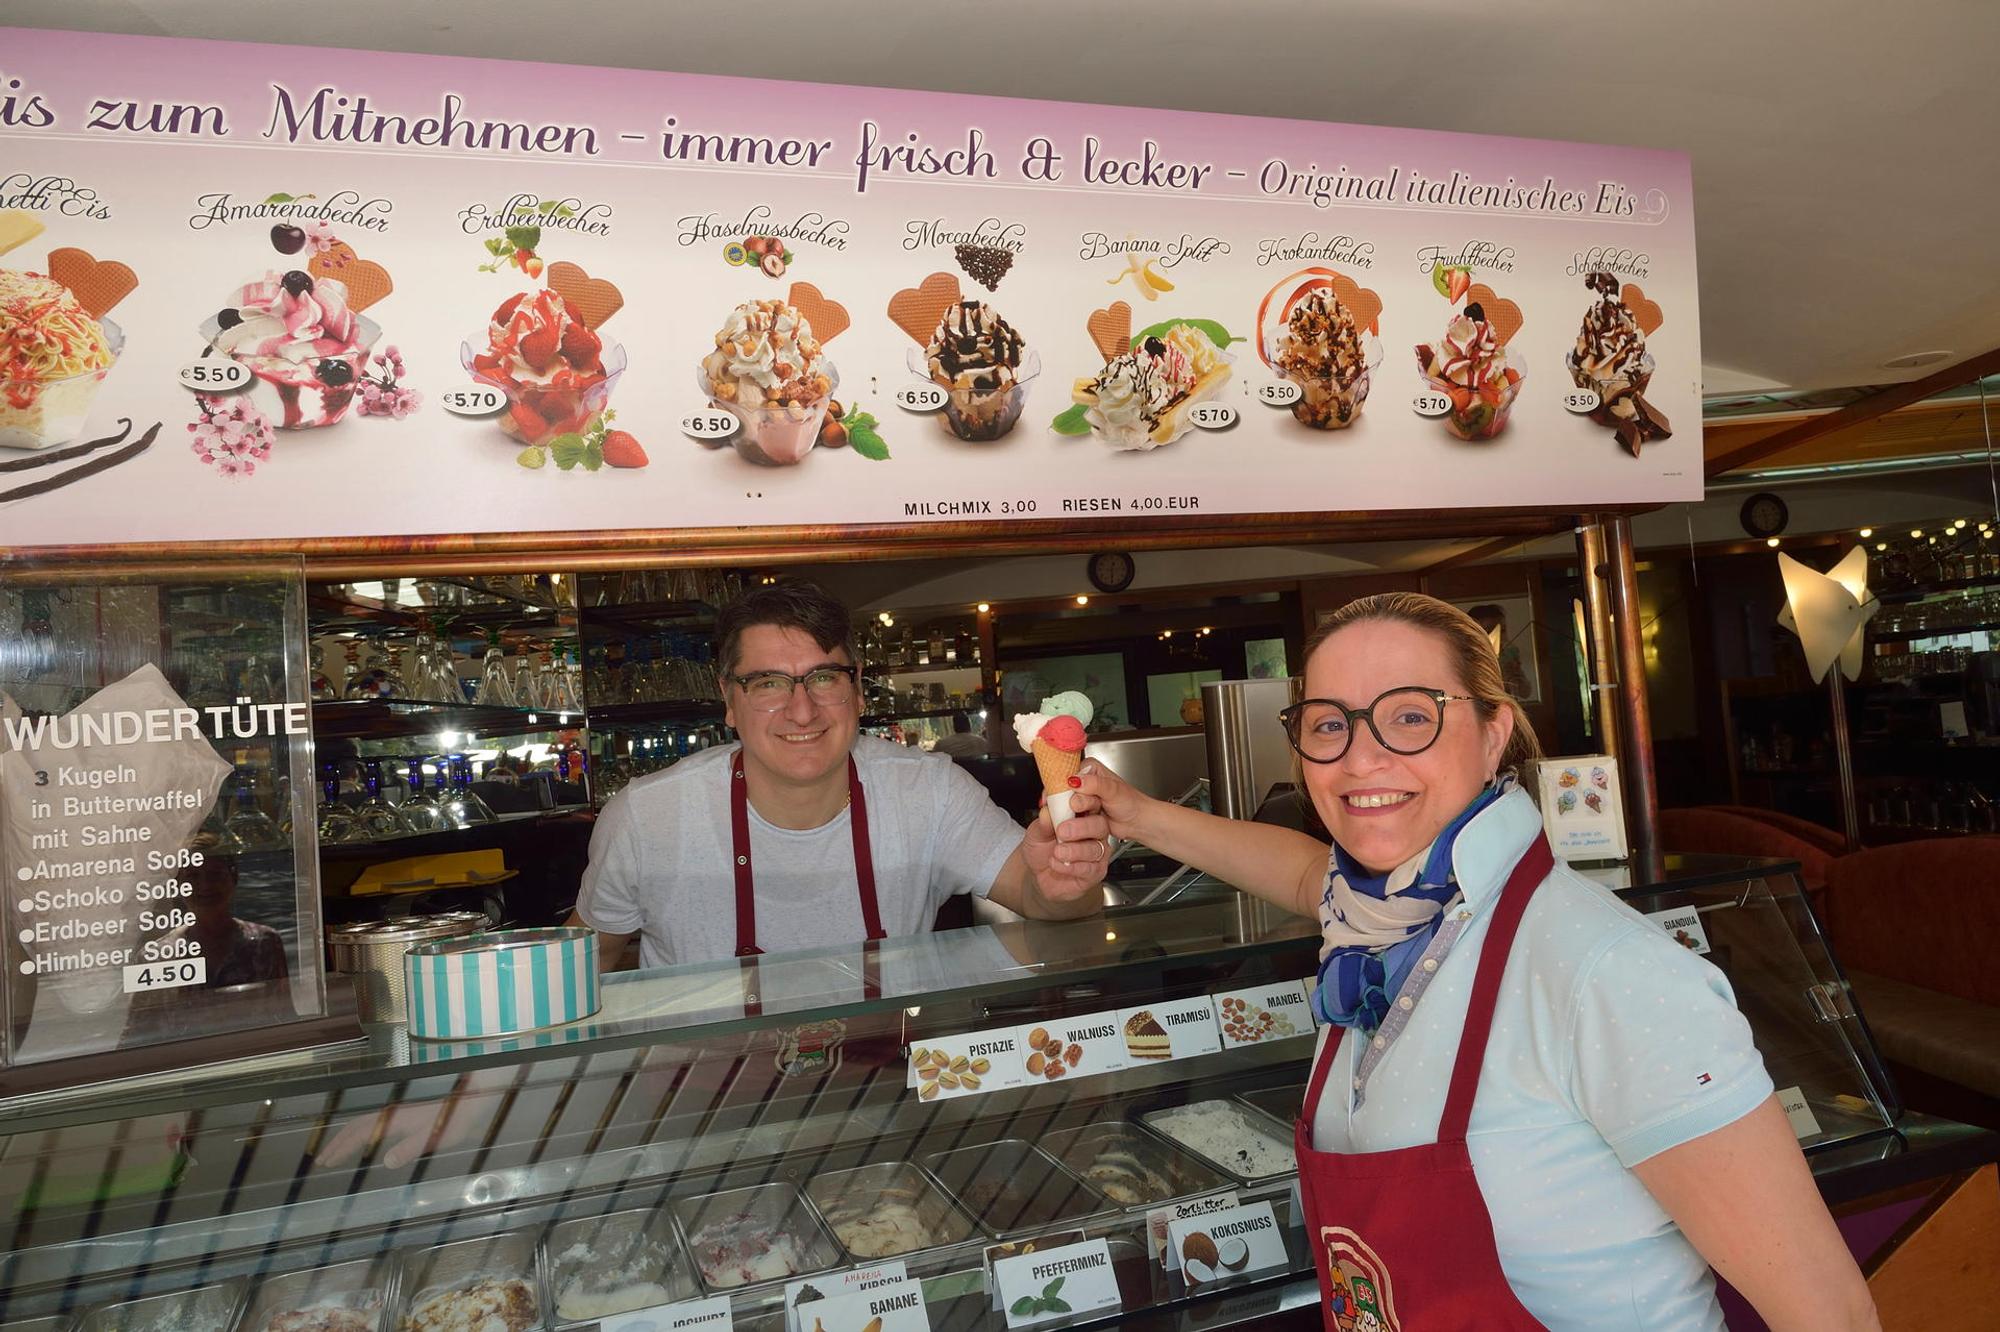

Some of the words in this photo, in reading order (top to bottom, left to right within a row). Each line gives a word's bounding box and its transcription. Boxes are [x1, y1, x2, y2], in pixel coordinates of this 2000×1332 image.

[0, 79, 54, 127] is
[87, 100, 229, 136] zum
[263, 84, 600, 155] Mitnehmen
[662, 118, 832, 167] immer
[856, 122, 998, 193] frisch
[1022, 138, 1062, 181] &
[1084, 137, 1212, 189] lecker
[1259, 160, 1399, 208] Original
[1406, 172, 1586, 213] italienisches
[1594, 182, 1637, 216] Eis
[60, 188, 111, 220] Eis
[190, 190, 393, 233] Amarenabecher
[458, 194, 612, 237] Erdbeerbecher
[677, 206, 850, 251] Haselnussbecher
[903, 218, 1026, 253] Moccabecher
[1080, 232, 1161, 261] Banana
[1160, 234, 1231, 268] Split
[1257, 232, 1375, 269] Krokantbecher
[1417, 240, 1516, 274] Fruchtbecher
[1566, 247, 1650, 279] Schokobecher
[904, 501, 991, 516] MILCHMIX
[1001, 500, 1037, 514] 3,00
[1063, 498, 1122, 511] RIESEN
[35, 771, 49, 786] 3
[58, 765, 137, 789] Kugeln
[32, 799, 50, 818] in
[64, 789, 202, 817] Butterwaffel
[32, 829, 68, 849] mit
[81, 825, 151, 847] Sahne
[33, 857, 135, 880] Amarena
[147, 849, 204, 871] Soße
[35, 886, 124, 912] Schoko
[135, 879, 193, 901] Soße
[36, 918, 127, 943] Erdbeer
[139, 908, 197, 932] Soße
[36, 948, 132, 974] Himbeer
[144, 938, 202, 961] Soße
[137, 963, 196, 986] 4.50
[1267, 993, 1304, 1008] MANDEL
[969, 1039, 1015, 1057] PISTAZIE
[1067, 1025, 1115, 1043] WALNUSS
[1210, 1216, 1272, 1240] KOKOSNUSS
[1032, 1253, 1108, 1280] PFEFFERMINZ
[870, 1293, 919, 1315] BANANE
